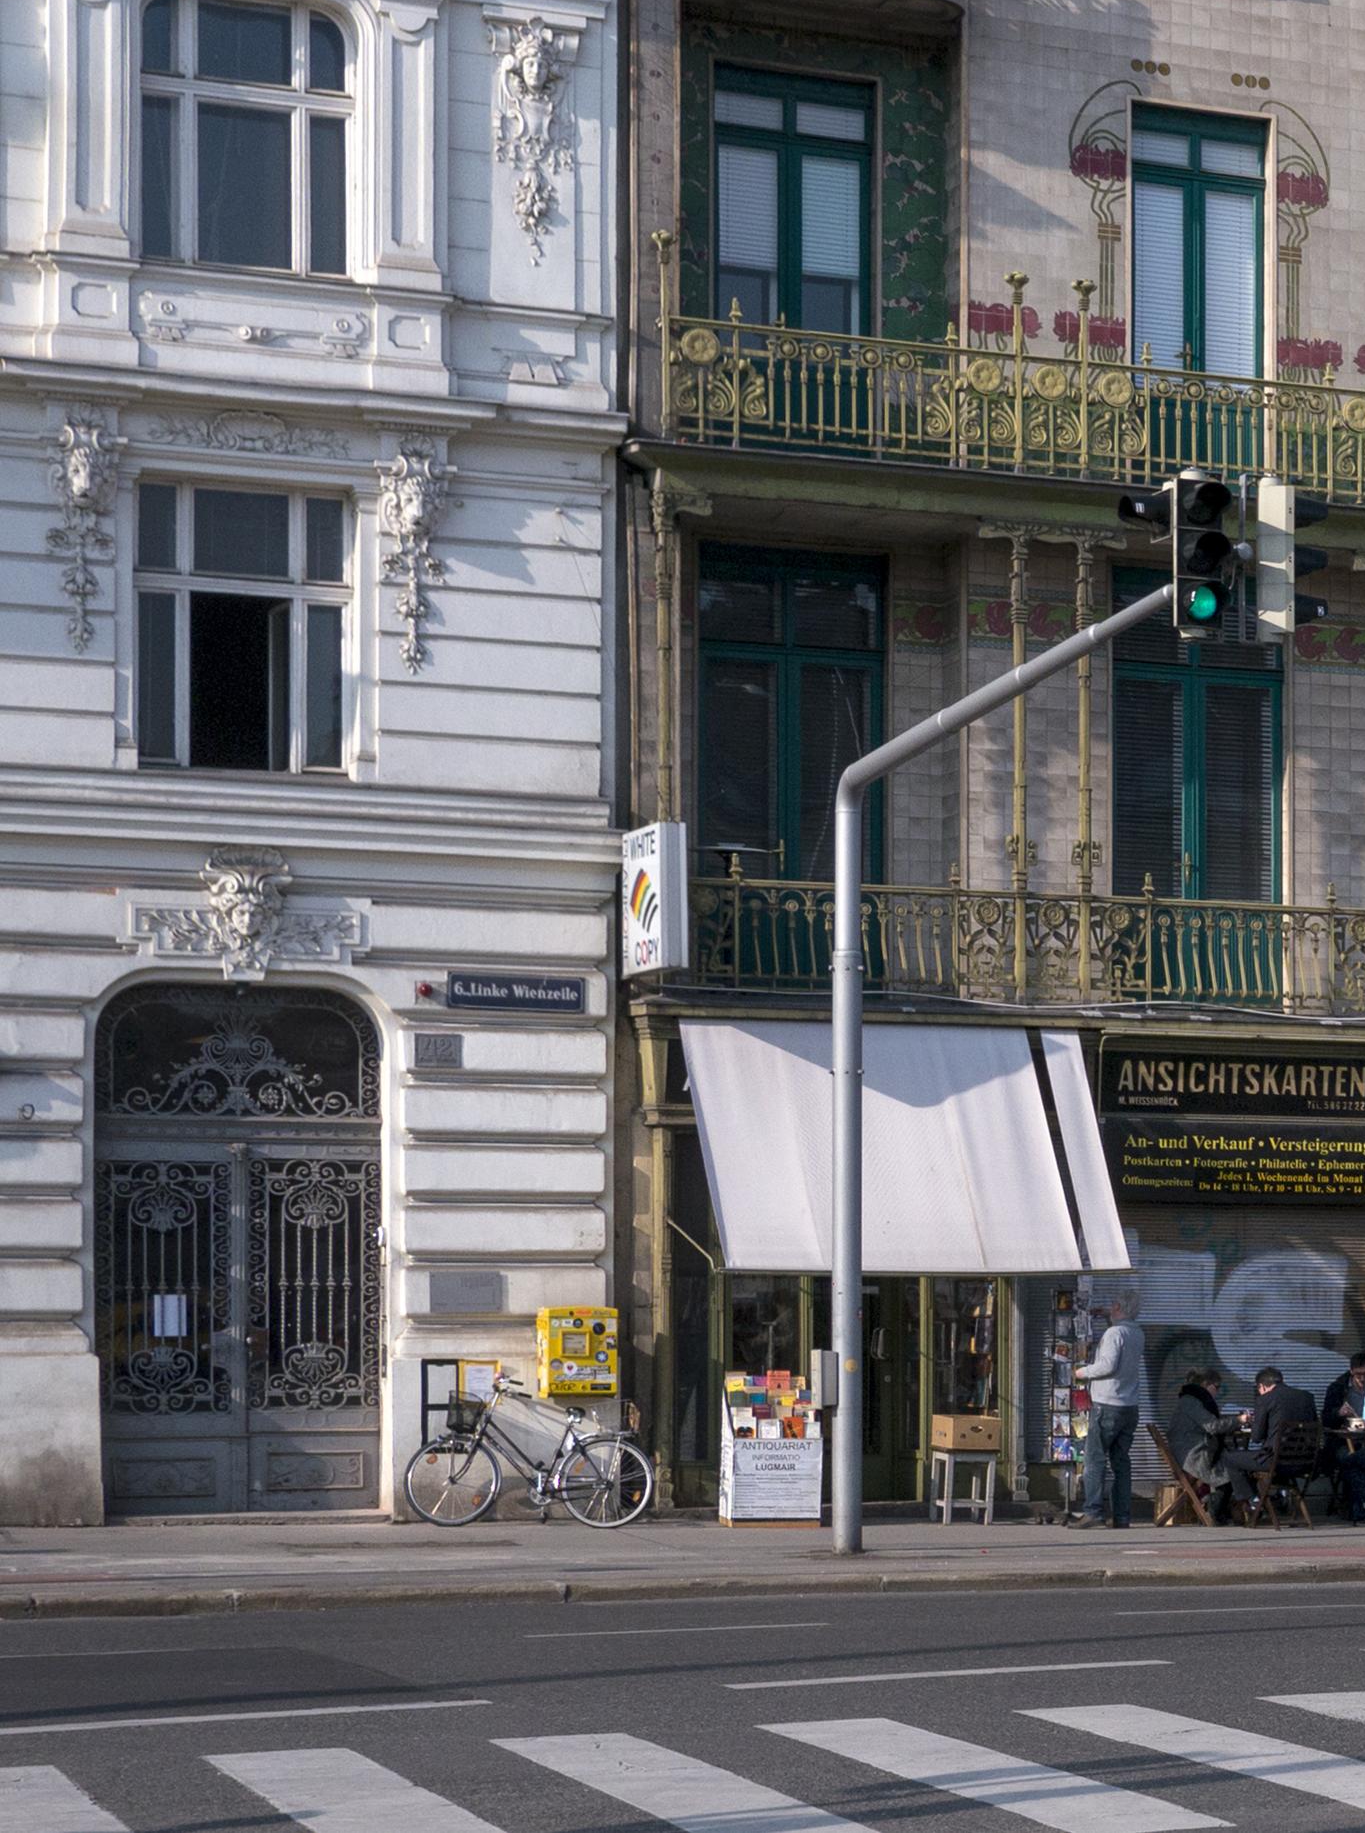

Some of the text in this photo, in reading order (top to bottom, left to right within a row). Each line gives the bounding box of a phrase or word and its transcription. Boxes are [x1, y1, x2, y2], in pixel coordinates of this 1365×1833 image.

[630, 830, 656, 861] WHITE
[635, 939, 659, 966] COPY
[470, 984, 508, 999] Linke
[512, 984, 578, 1001] Wienzeile
[1124, 1134, 1153, 1149] An-
[1158, 1135, 1188, 1149] und
[1192, 1135, 1255, 1150] Verkauf
[1123, 1155, 1182, 1166] Postkarten
[1193, 1156, 1248, 1168] Fotografie
[1259, 1158, 1308, 1169] Philatelie
[1258, 1172, 1313, 1183] Wochenende
[1333, 1173, 1363, 1183] Monat
[741, 1441, 813, 1451] ANTIQUARIAT
[755, 1463, 796, 1471] LUGMAIR
